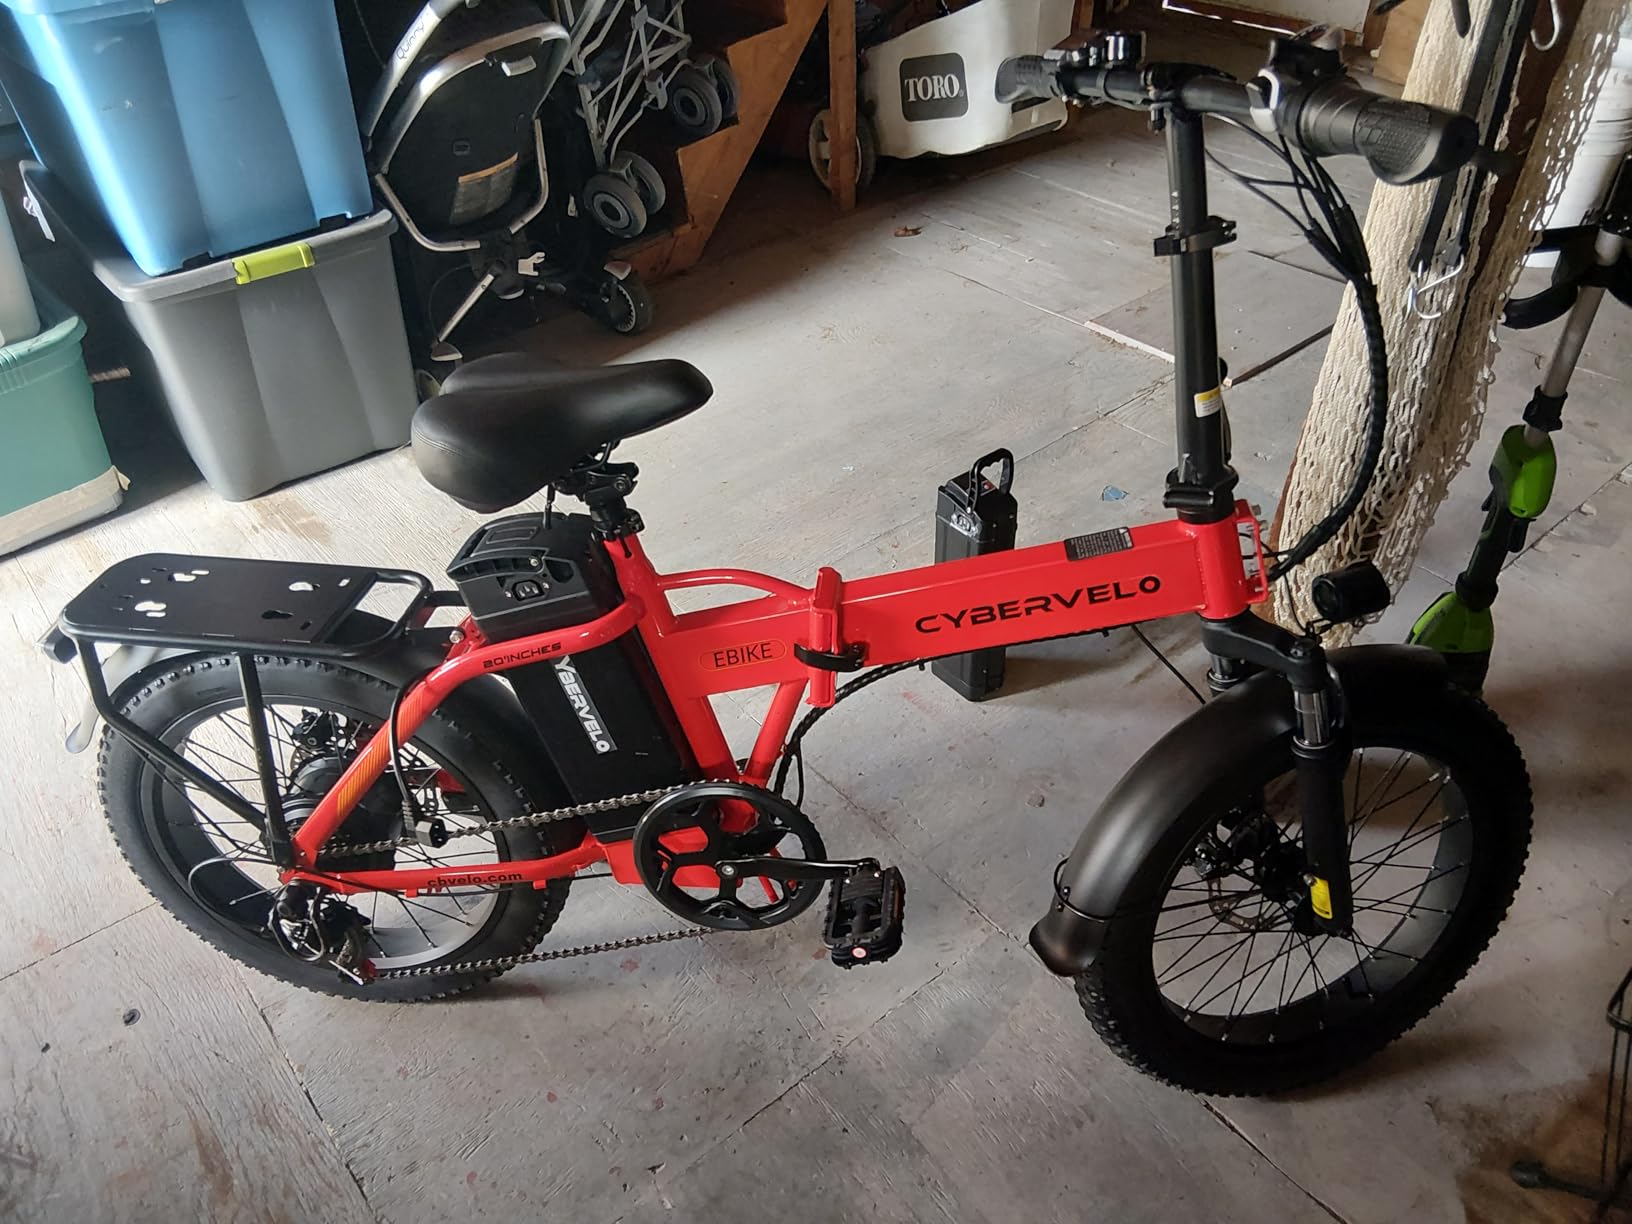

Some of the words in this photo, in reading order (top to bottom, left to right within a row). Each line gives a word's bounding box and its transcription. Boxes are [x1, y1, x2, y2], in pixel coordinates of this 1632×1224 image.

[396, 20, 425, 60] Quinny
[904, 73, 960, 102] TORO
[915, 575, 1161, 633] CYBERVELO
[713, 642, 773, 668] EBIKE
[554, 655, 610, 753] YBERVELO
[427, 873, 522, 888] cbvelo.com
